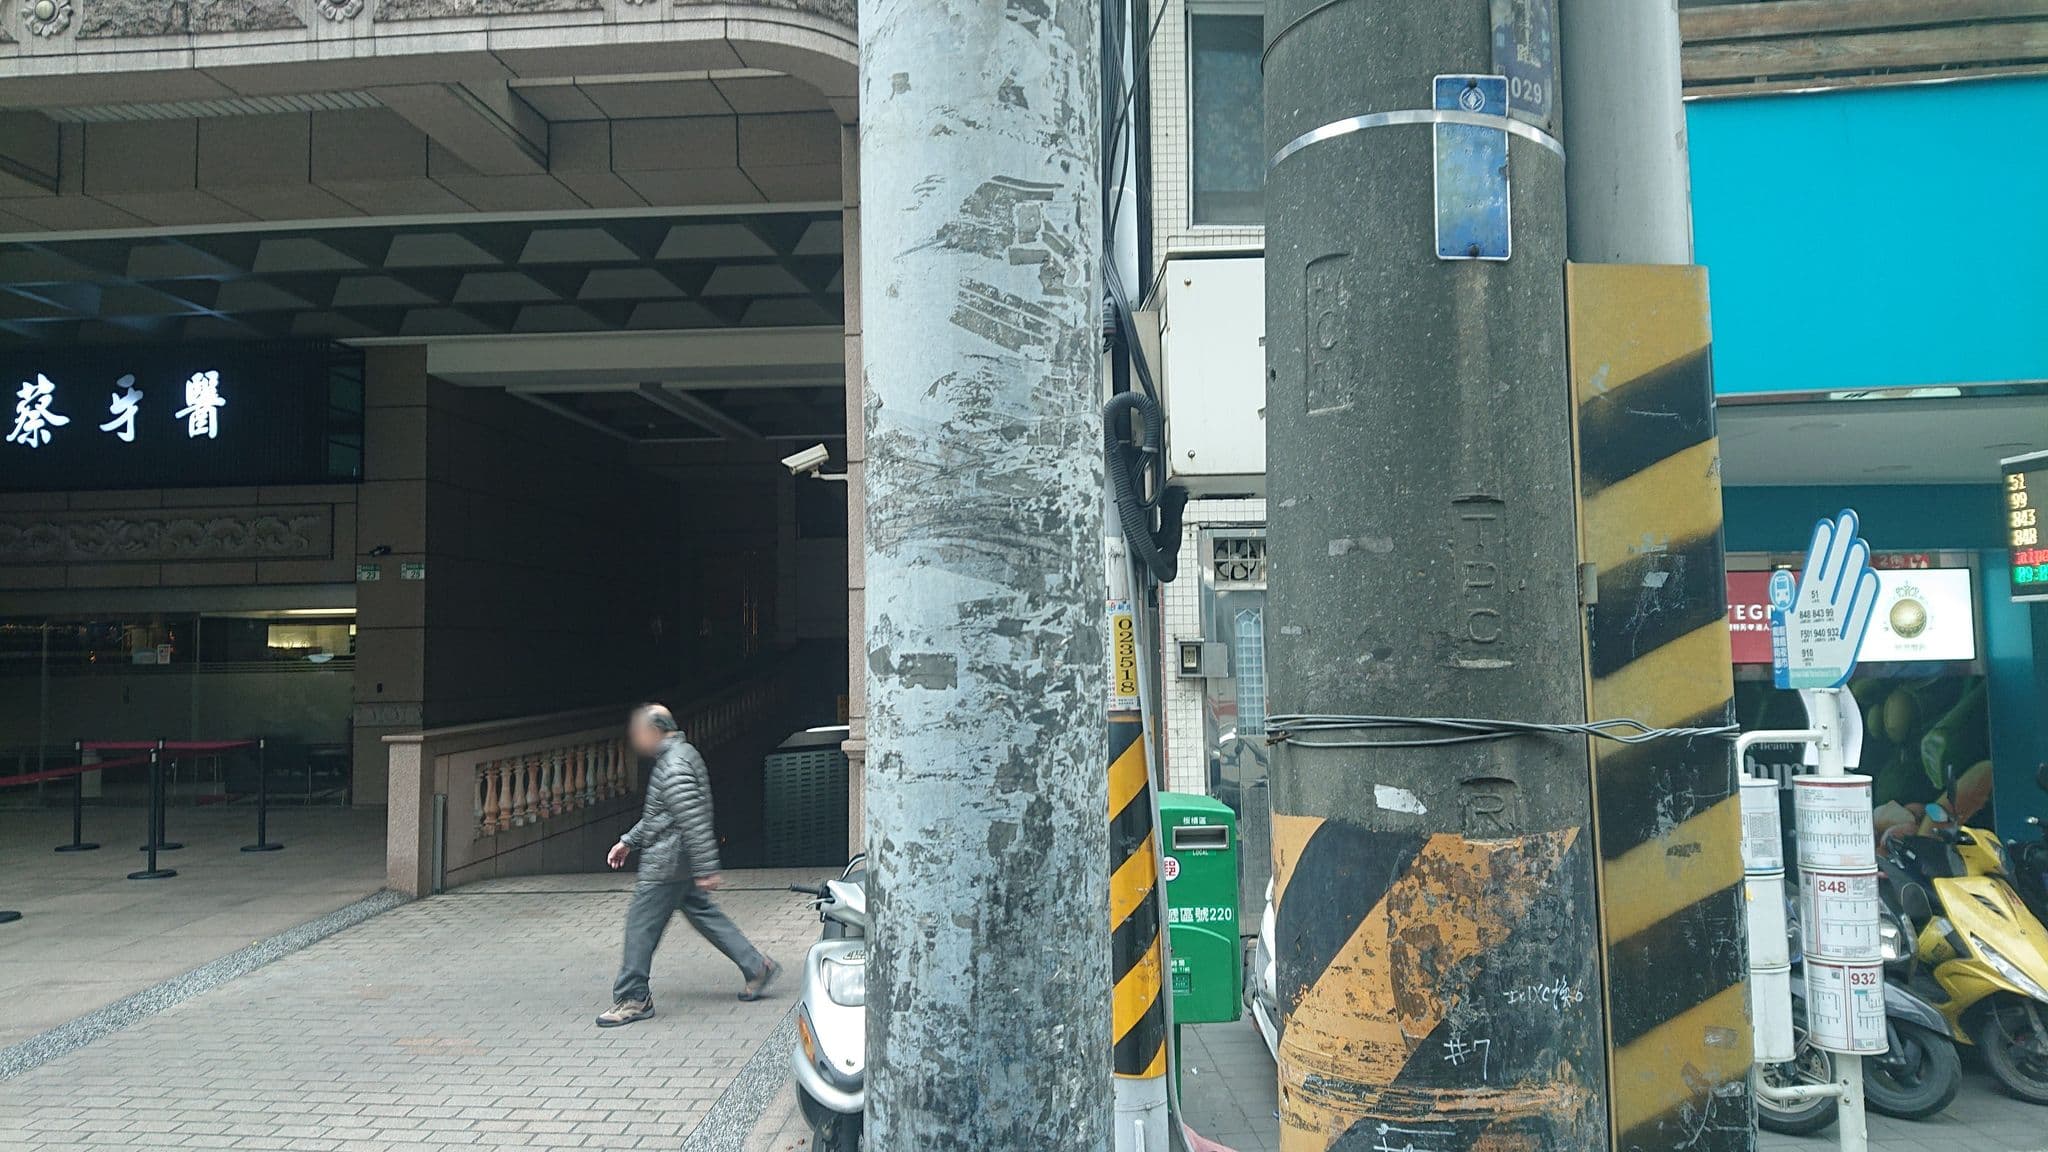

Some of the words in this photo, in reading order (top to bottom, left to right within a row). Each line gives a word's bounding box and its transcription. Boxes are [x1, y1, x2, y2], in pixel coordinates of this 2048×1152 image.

[1811, 590, 1819, 599] 51
[1825, 608, 1834, 617] 99
[1118, 618, 1135, 693] 023518
[1818, 880, 1847, 894] 848
[1851, 972, 1876, 986] 932
